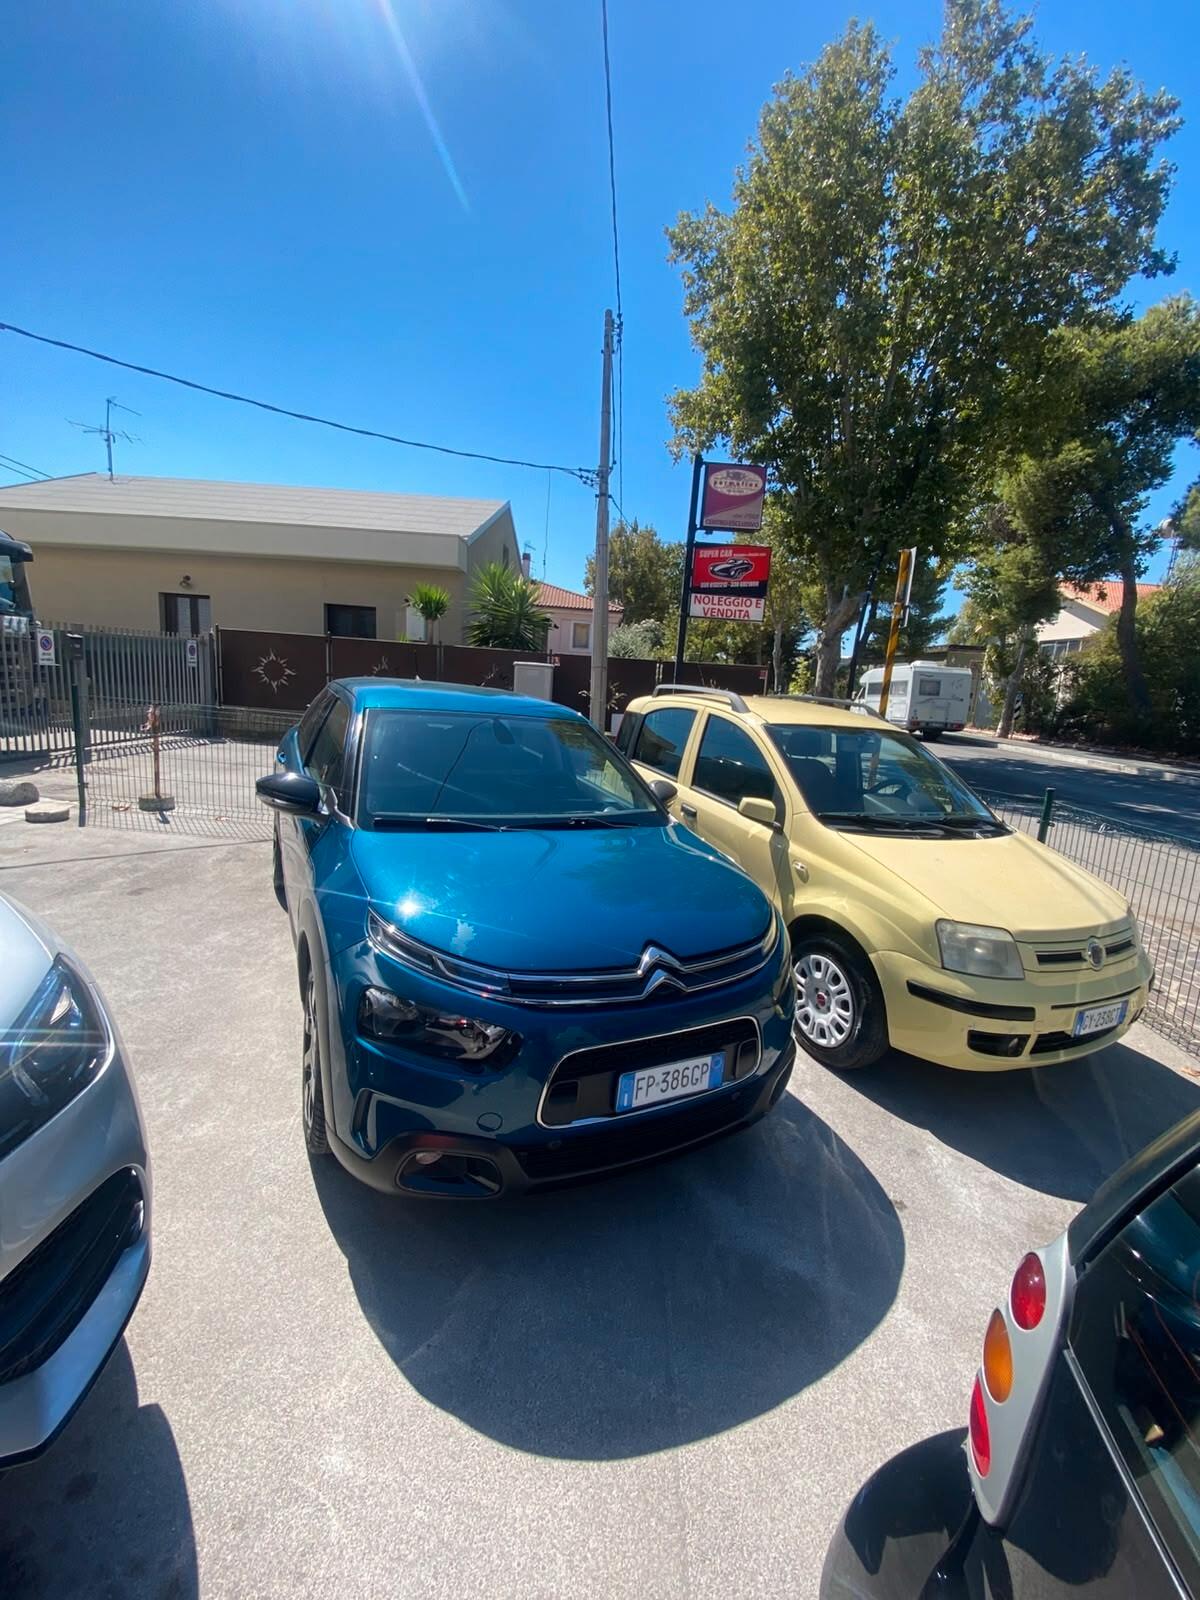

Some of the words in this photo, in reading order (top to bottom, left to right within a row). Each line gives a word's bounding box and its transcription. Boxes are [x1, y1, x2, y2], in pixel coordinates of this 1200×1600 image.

[699, 549, 719, 558] SUPER
[720, 548, 733, 558] CAR
[694, 595, 752, 608] NOLEGGIO
[755, 599, 762, 609] E
[702, 607, 750, 619] VENDITA
